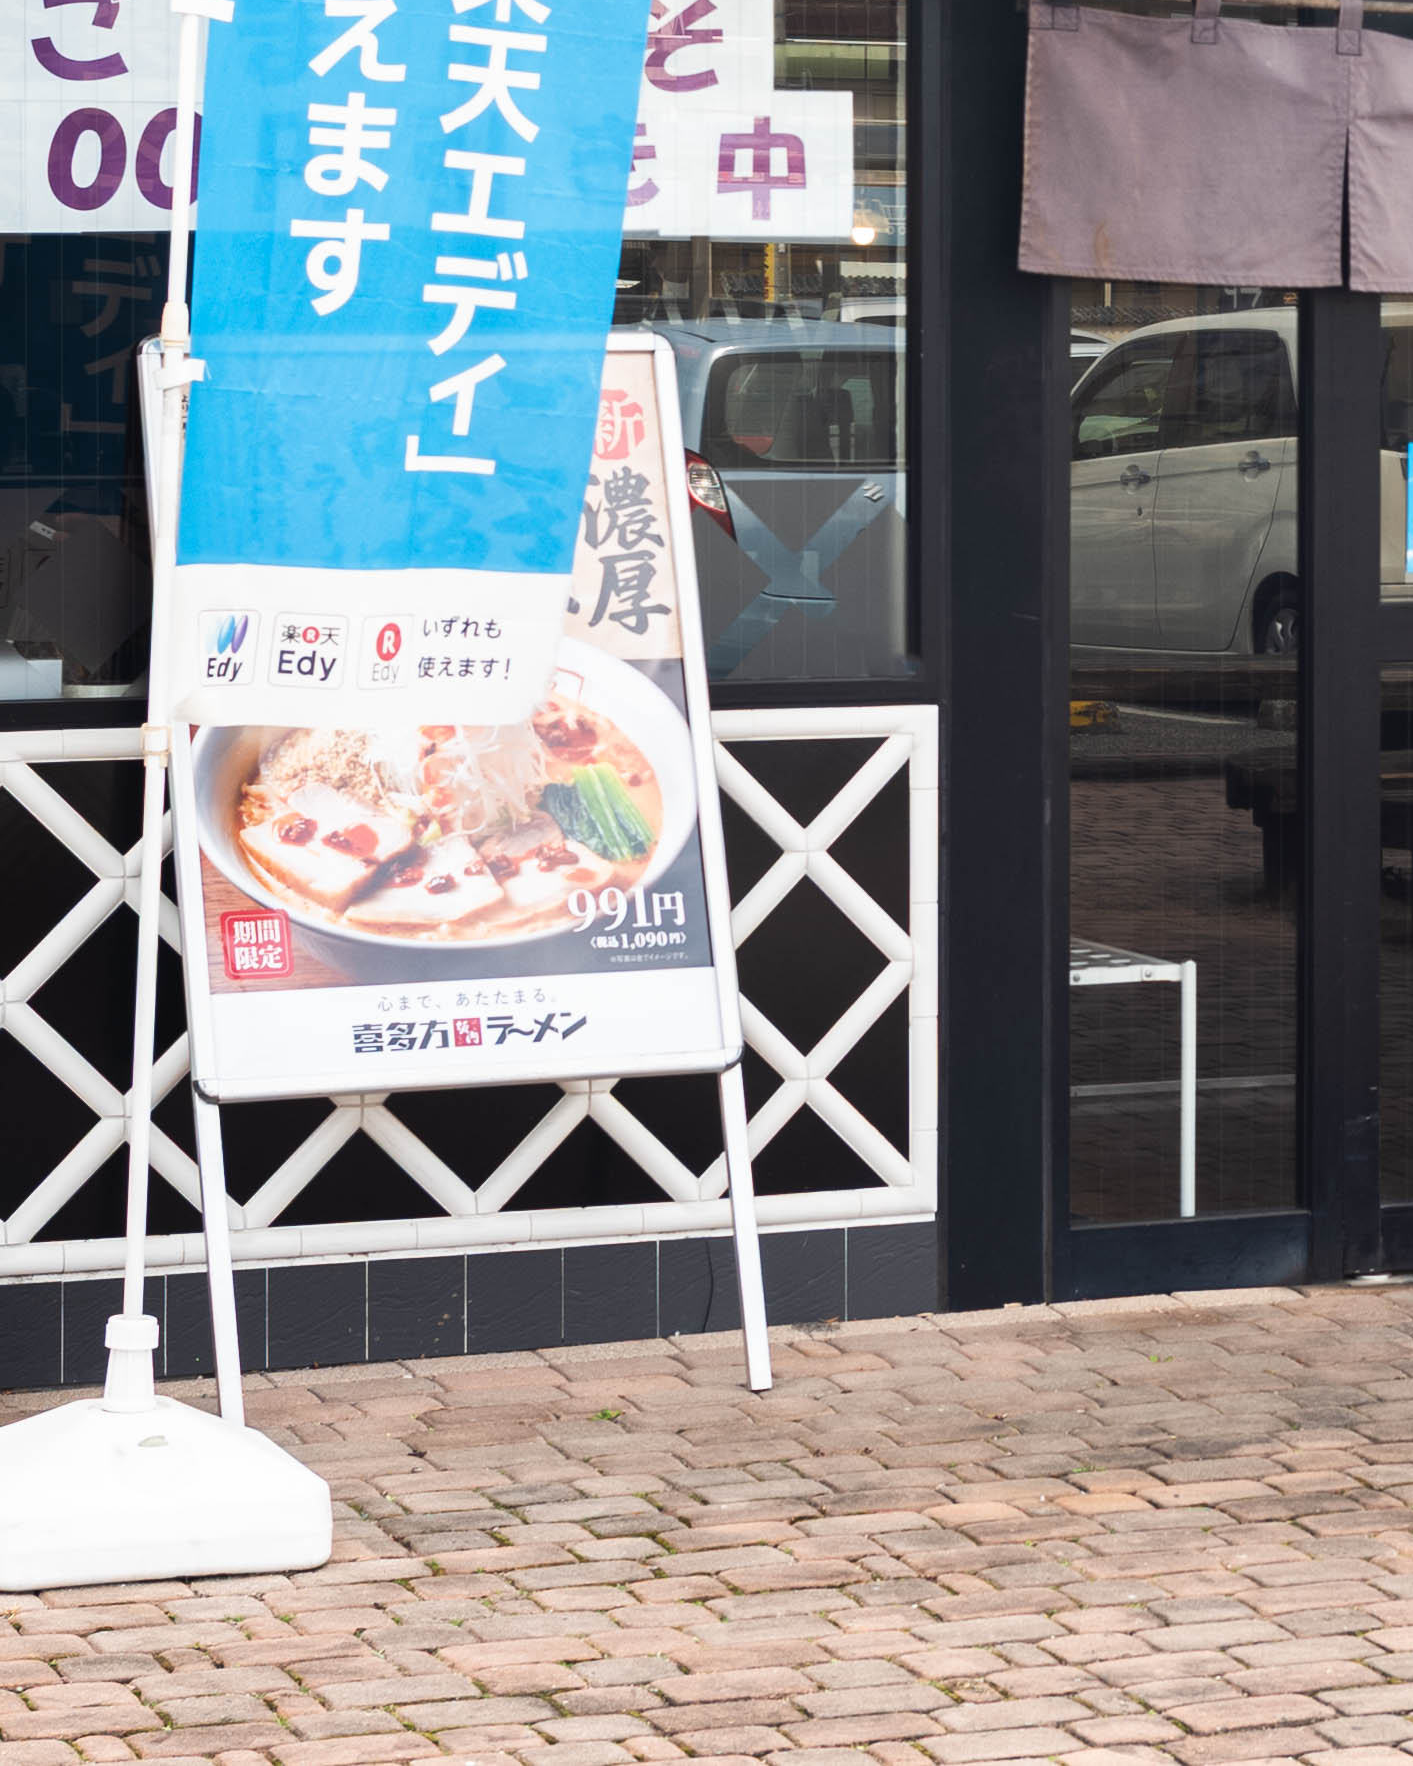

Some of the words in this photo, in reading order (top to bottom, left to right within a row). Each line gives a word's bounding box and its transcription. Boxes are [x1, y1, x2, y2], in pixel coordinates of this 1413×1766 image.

[422, 616, 502, 640] いずれも
[206, 657, 243, 682] Edy
[278, 650, 337, 682] Edy
[371, 661, 399, 684] Edy
[567, 886, 686, 933] 991円
[233, 919, 281, 945] 期間
[234, 945, 283, 971] 限定
[352, 1020, 450, 1054] 喜多方
